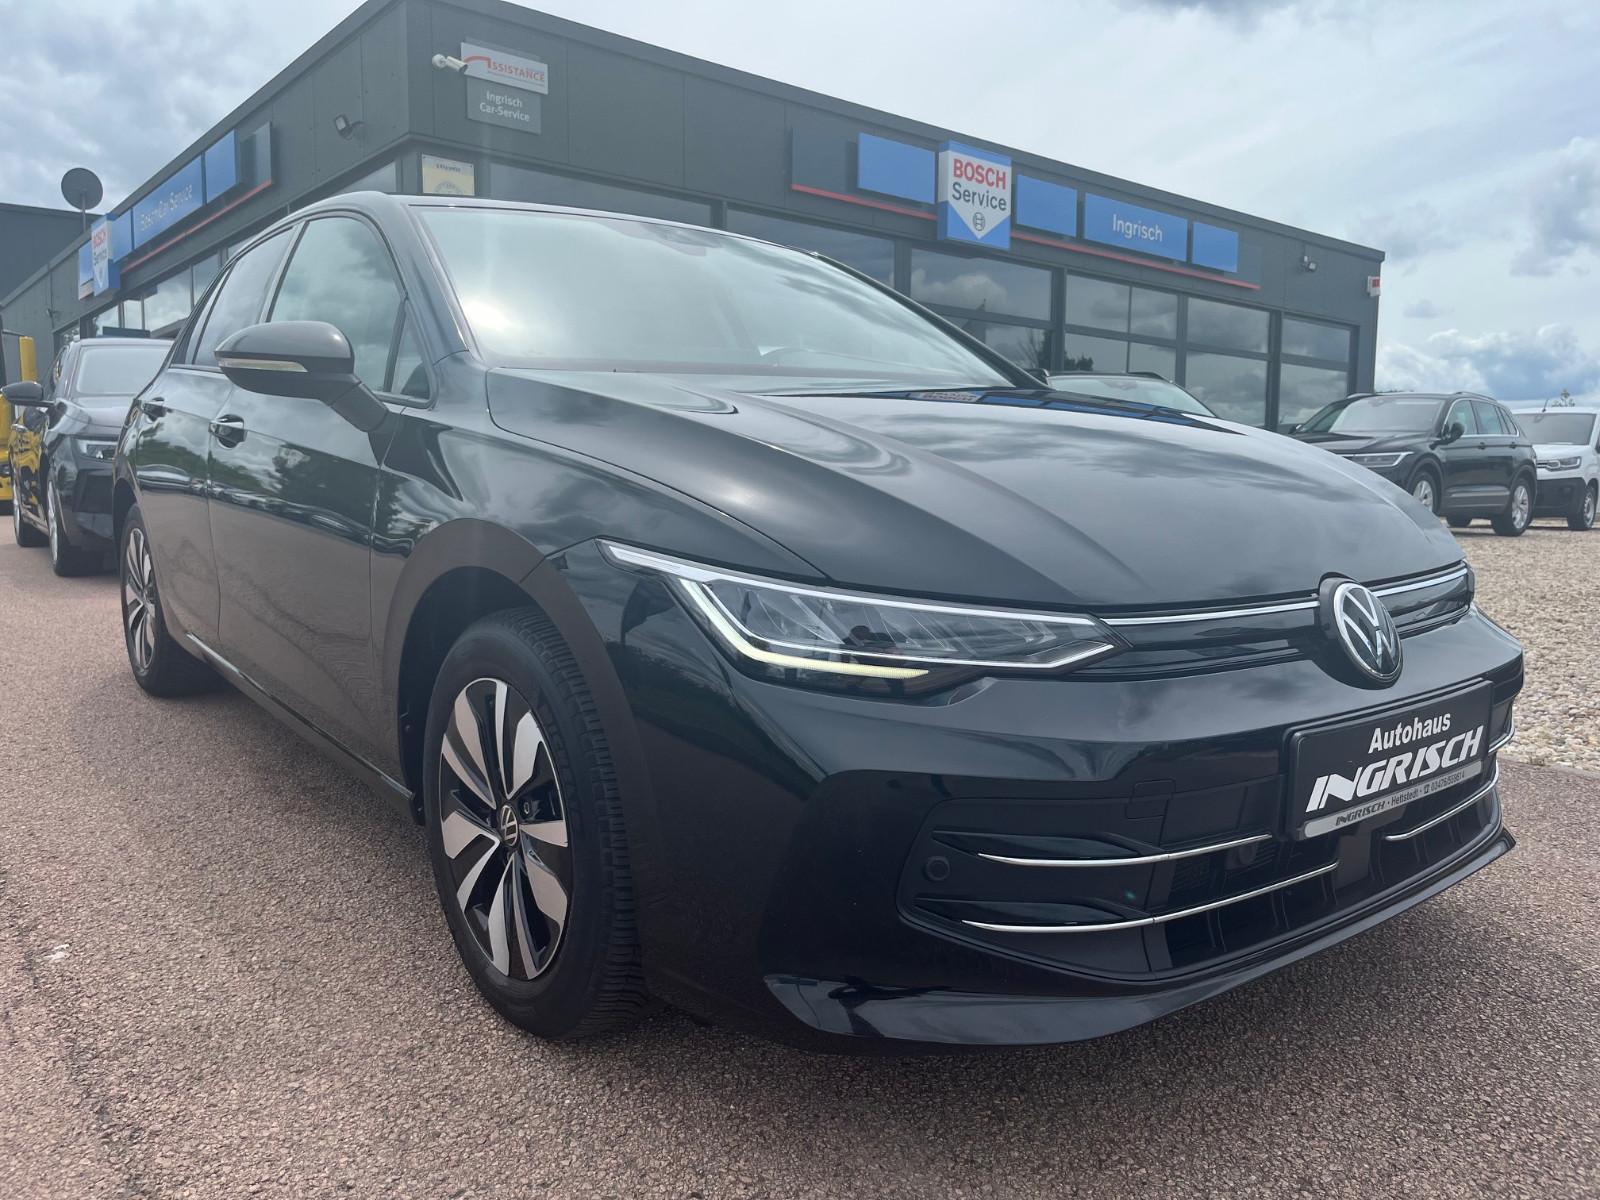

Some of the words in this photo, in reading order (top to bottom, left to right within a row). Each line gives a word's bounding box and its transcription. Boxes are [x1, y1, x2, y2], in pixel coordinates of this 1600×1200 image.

[479, 102, 531, 122] Car-Service
[486, 91, 523, 108] Ingrisch
[953, 158, 1007, 190] BOSCH
[952, 181, 1007, 211] Service
[1112, 213, 1163, 242] Ingrisch
[1368, 713, 1451, 754] Autohaus
[1305, 725, 1484, 813] INGRISCH
[1336, 800, 1386, 826] INGRISCH
